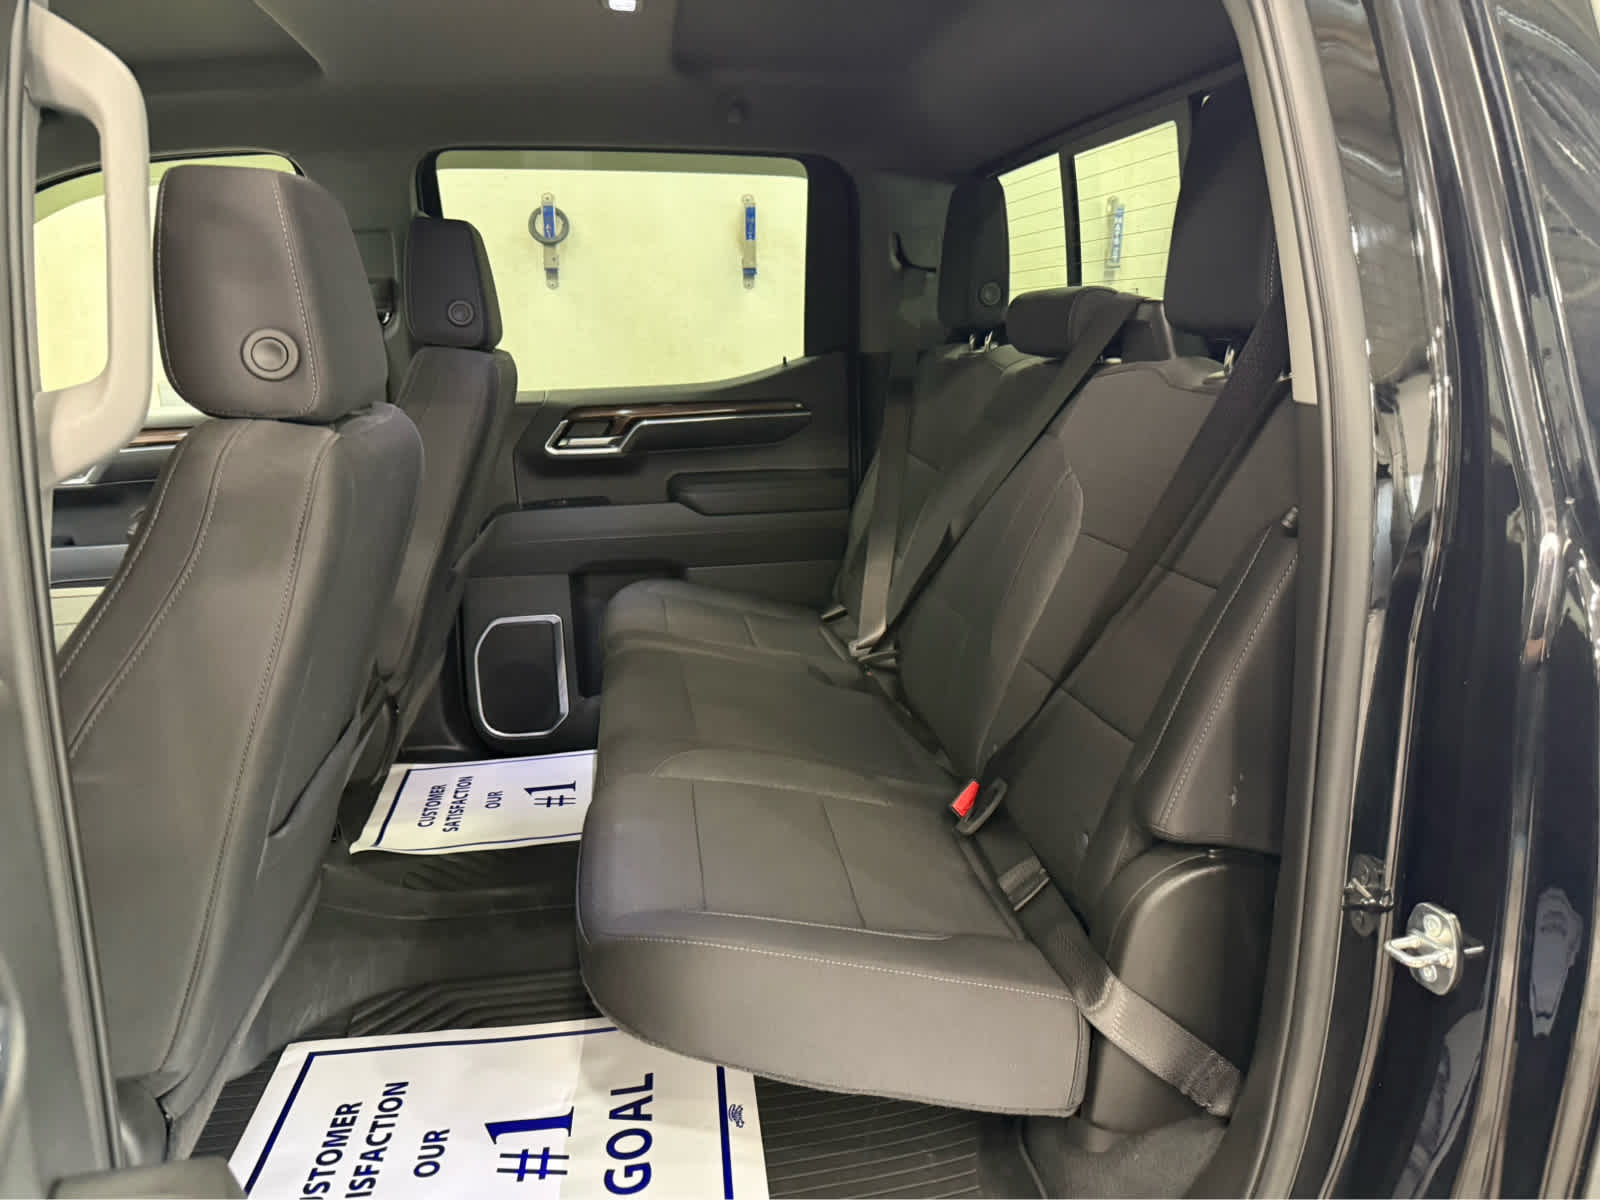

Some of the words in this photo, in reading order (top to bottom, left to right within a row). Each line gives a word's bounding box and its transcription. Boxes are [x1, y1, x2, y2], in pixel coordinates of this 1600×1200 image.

[417, 783, 448, 828] CUSTOMER
[442, 775, 473, 833] SATISFACTION
[485, 790, 504, 809] OUR
[523, 780, 577, 808] #1
[298, 1101, 363, 1200] STOMER
[413, 1129, 450, 1178] OUR
[485, 1106, 575, 1182] #1
[603, 1072, 654, 1195] GOAL
